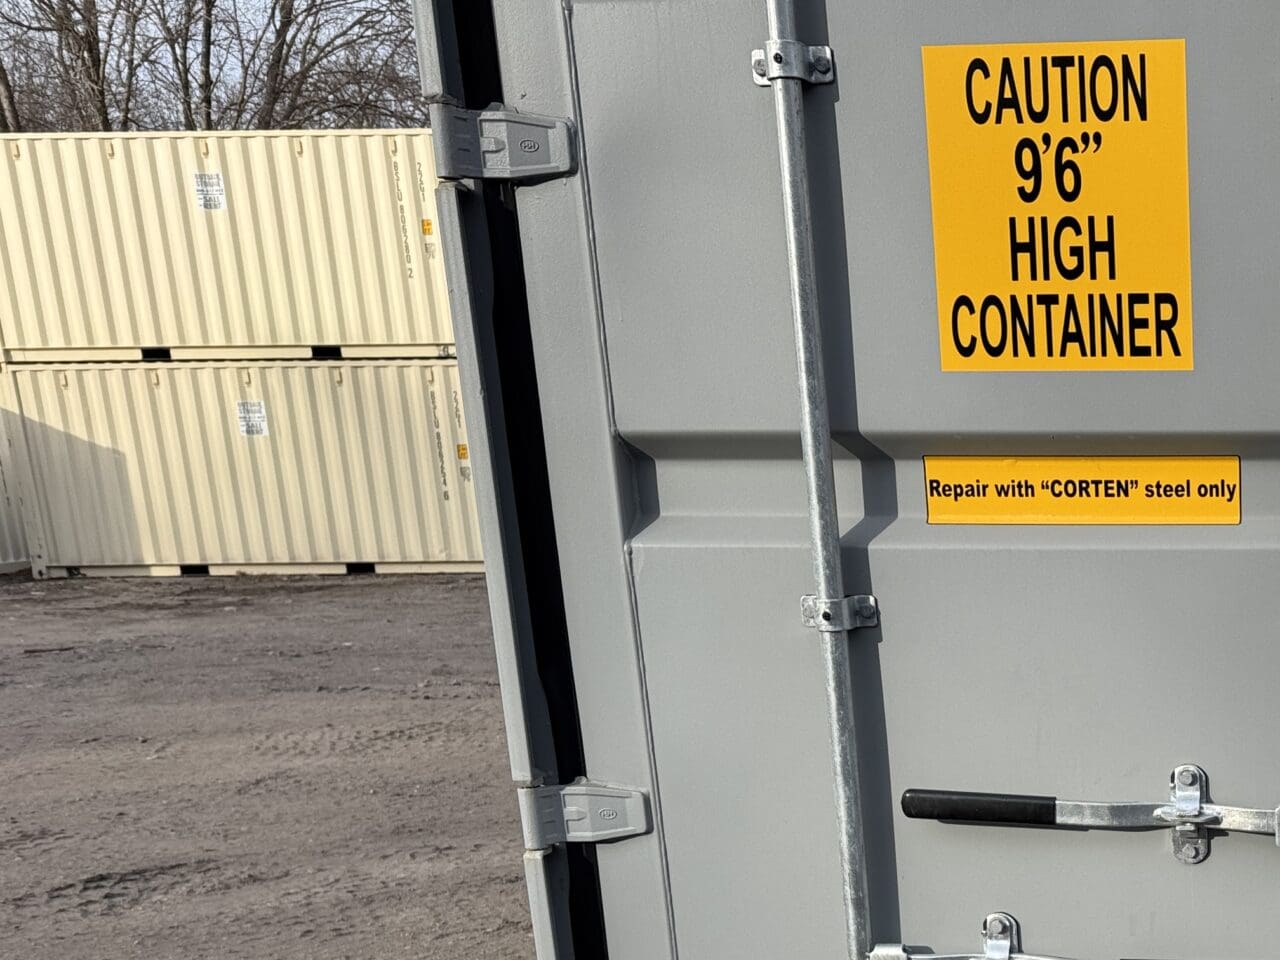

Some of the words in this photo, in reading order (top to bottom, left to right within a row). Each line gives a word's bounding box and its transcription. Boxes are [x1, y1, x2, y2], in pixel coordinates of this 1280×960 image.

[965, 53, 1148, 125] CAUTION
[1008, 215, 1117, 282] HIGH
[951, 292, 1182, 358] CONTAINER
[928, 479, 989, 502] Repair
[994, 479, 1035, 498] with
[1144, 479, 1191, 498] steel
[1197, 478, 1237, 503] only
